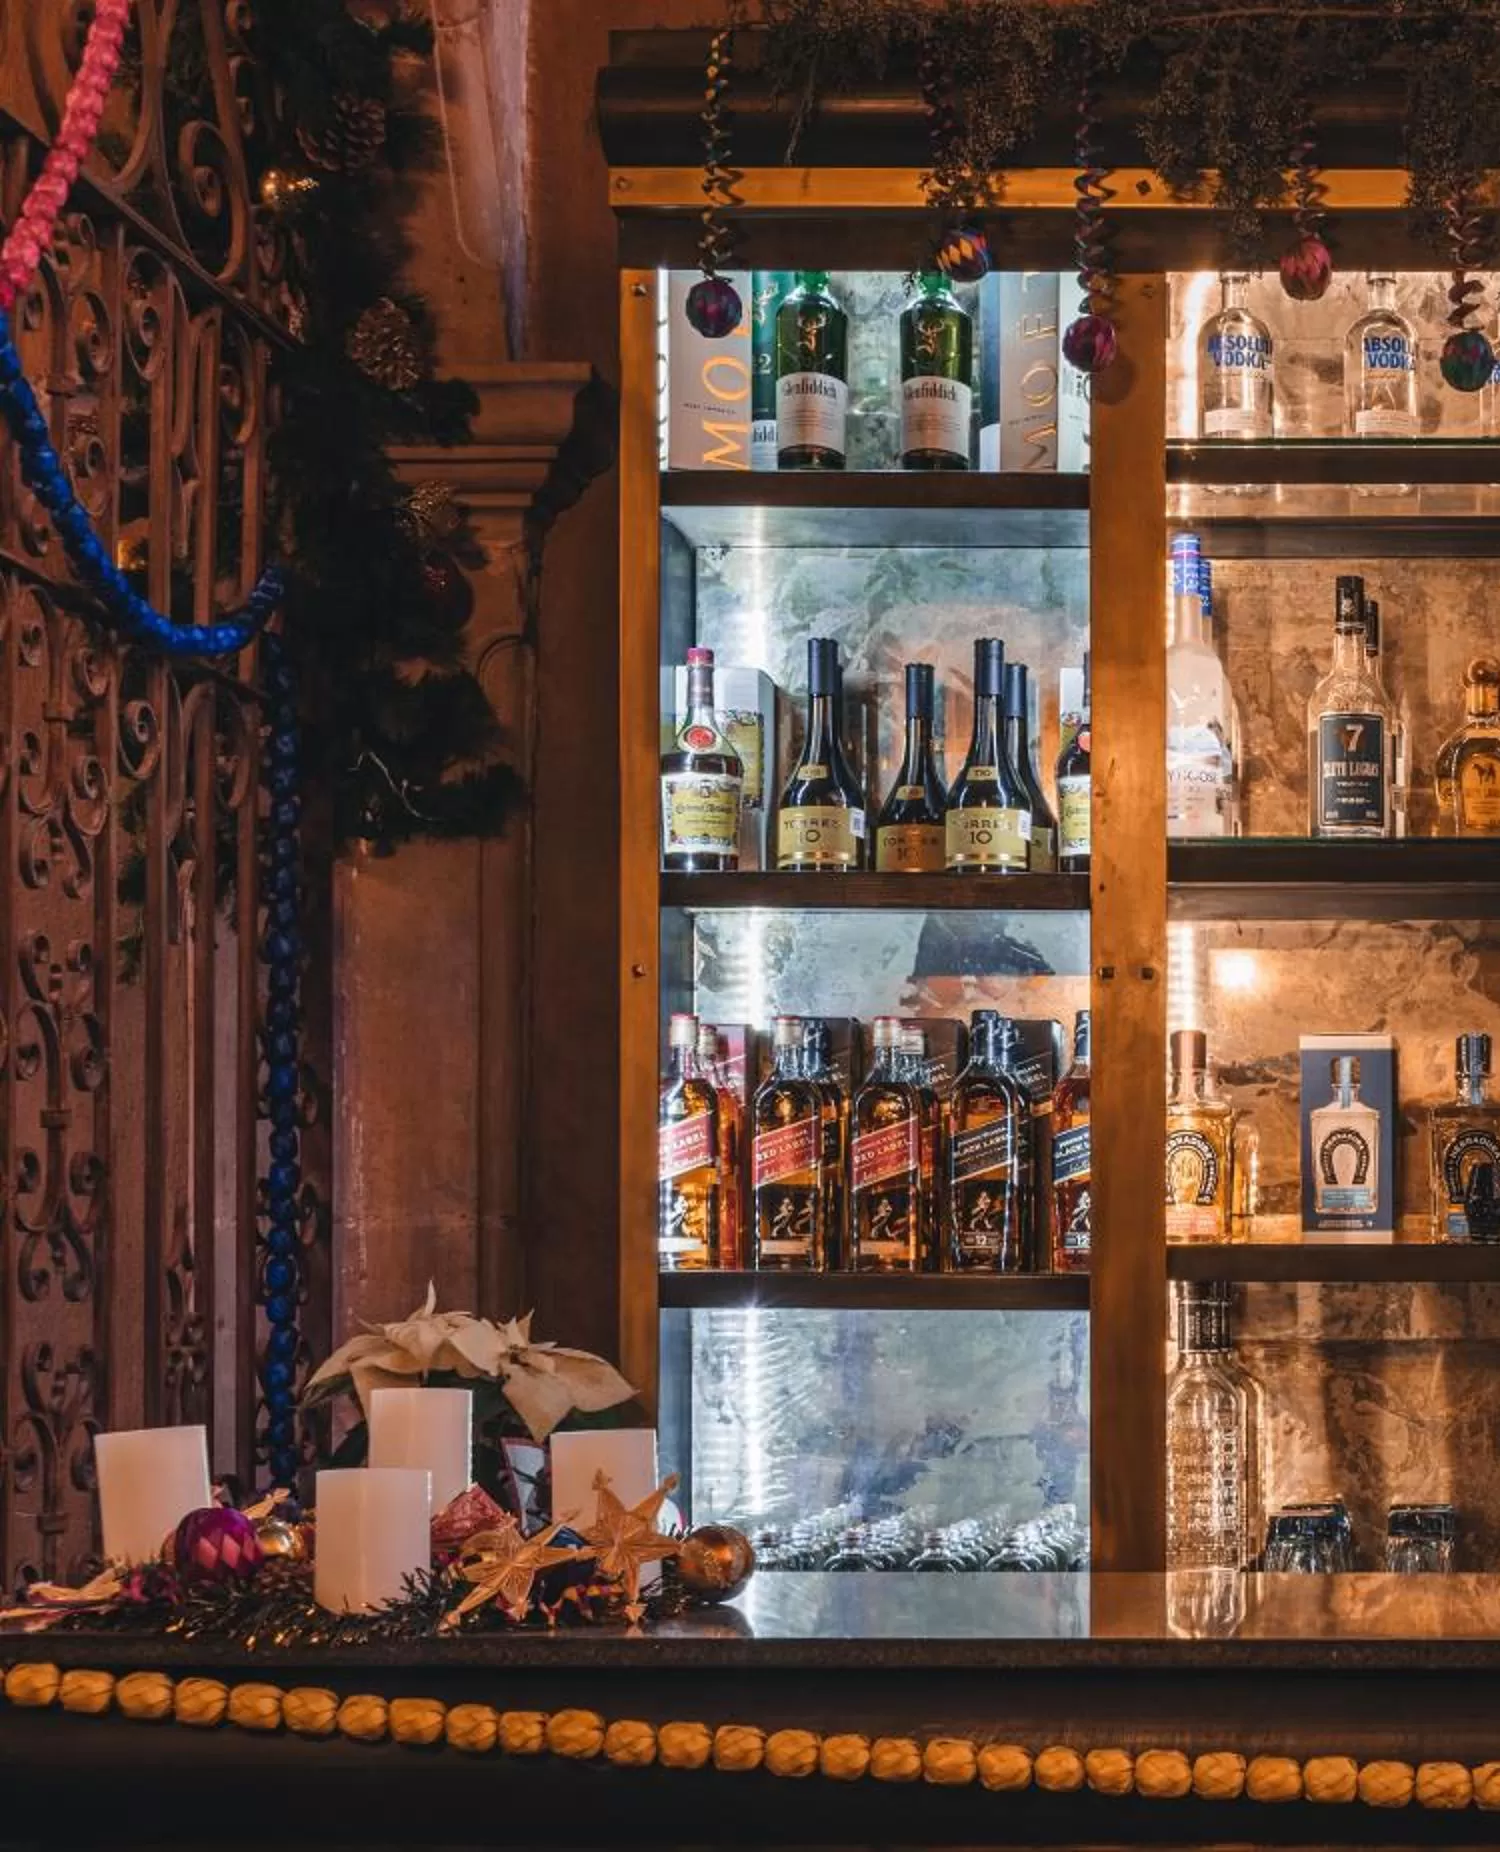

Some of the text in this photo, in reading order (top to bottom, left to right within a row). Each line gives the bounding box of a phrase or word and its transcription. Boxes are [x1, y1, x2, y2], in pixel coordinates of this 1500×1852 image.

[1364, 336, 1413, 352] ABSOL
[1346, 723, 1365, 752] 7
[970, 830, 993, 845] 10
